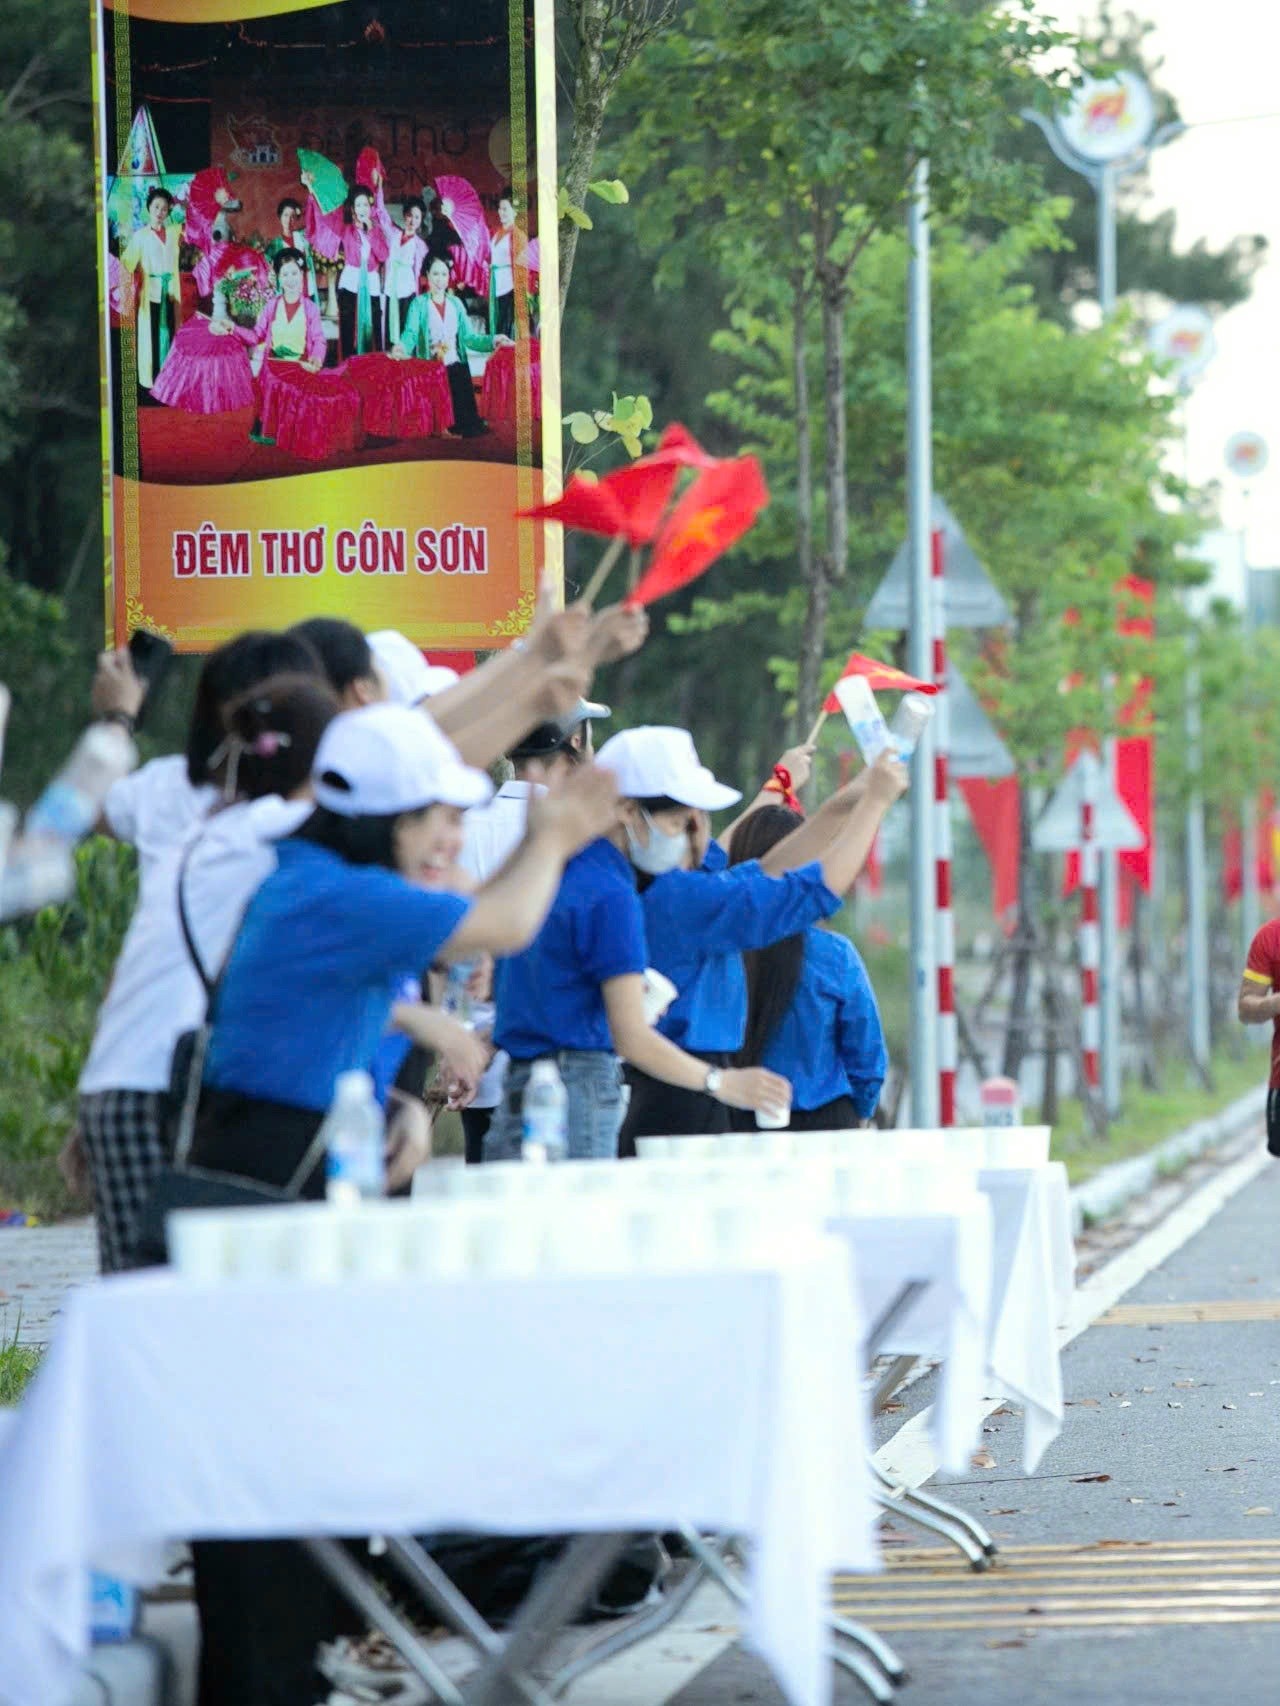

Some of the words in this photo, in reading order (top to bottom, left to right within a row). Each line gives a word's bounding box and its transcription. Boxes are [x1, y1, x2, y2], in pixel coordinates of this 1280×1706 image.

[174, 523, 250, 576] ĐÊM
[260, 526, 326, 575] THƠ
[335, 520, 405, 575] CÔN
[416, 525, 486, 575] SƠN
